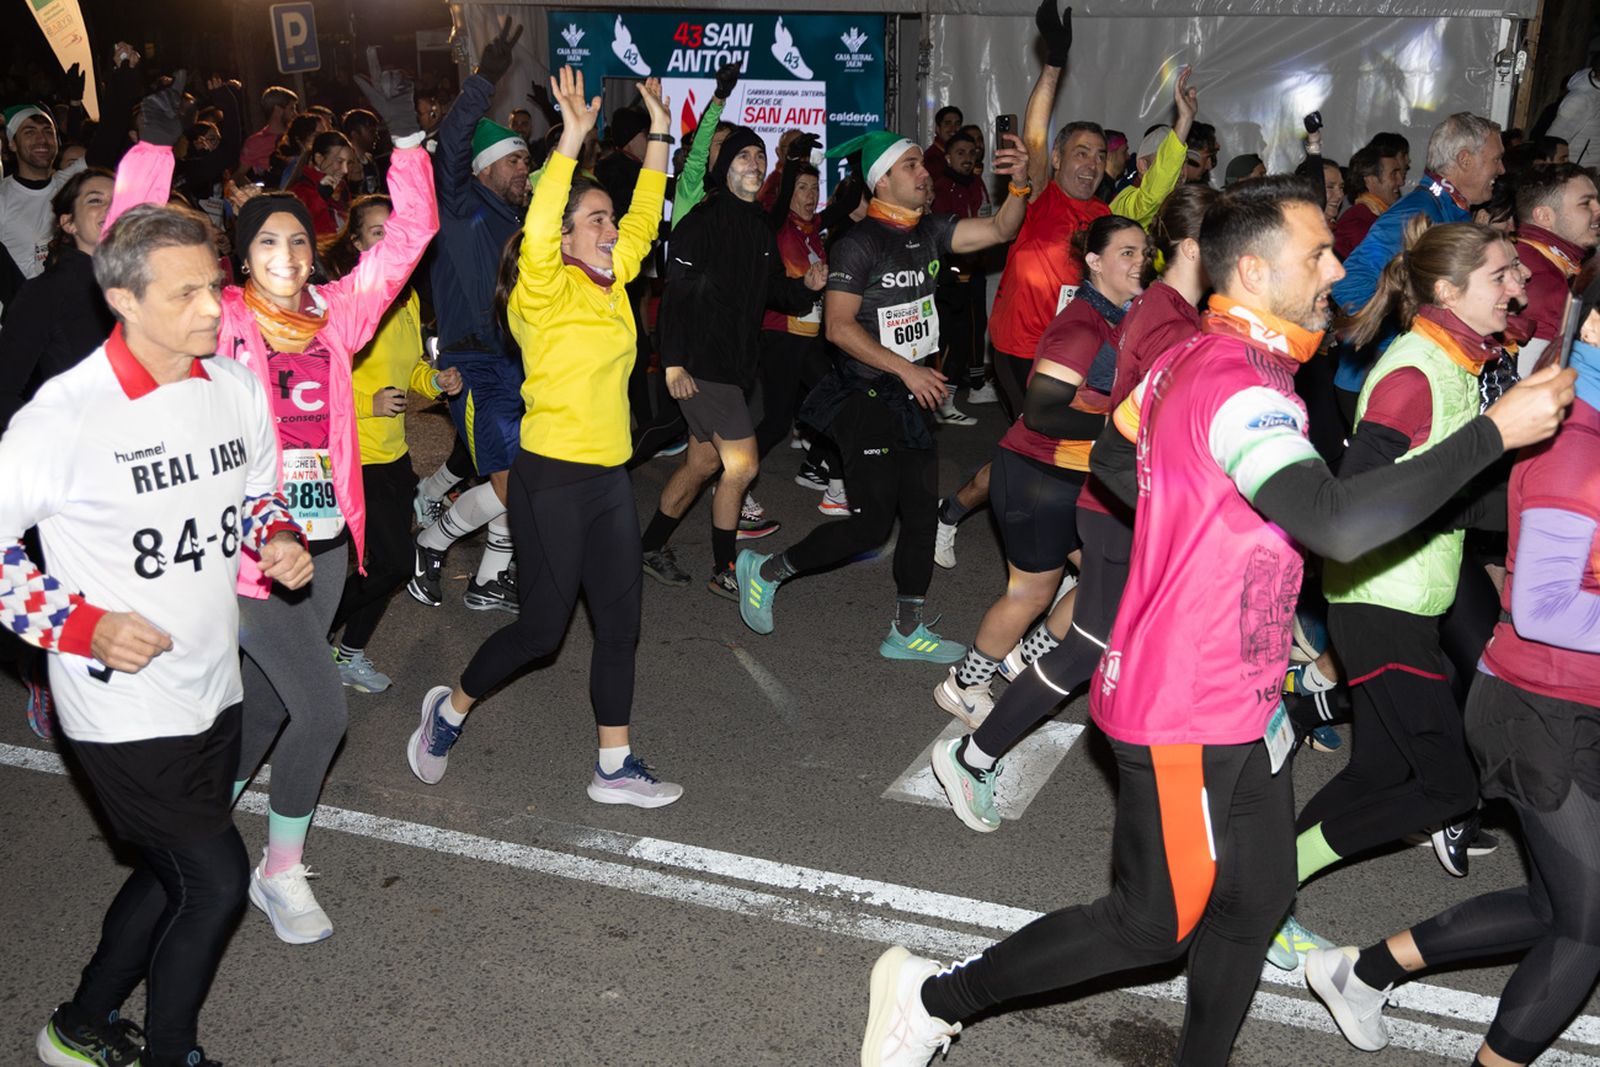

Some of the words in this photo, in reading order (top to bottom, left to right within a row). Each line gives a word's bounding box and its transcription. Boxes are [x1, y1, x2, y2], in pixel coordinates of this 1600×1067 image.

[281, 12, 308, 64] P
[673, 22, 703, 48] 43
[703, 22, 754, 47] SAN
[623, 48, 638, 66] 43
[784, 51, 799, 69] 43
[746, 98, 772, 106] NOCHE
[773, 98, 783, 106] DE
[774, 89, 800, 97] URBANA
[743, 106, 782, 124] SAN
[829, 112, 879, 122] calderón
[894, 319, 930, 345] 6091
[114, 441, 166, 463] hummel
[131, 453, 199, 494] REAL
[210, 437, 247, 476] JAEN
[283, 482, 336, 509] 3839
